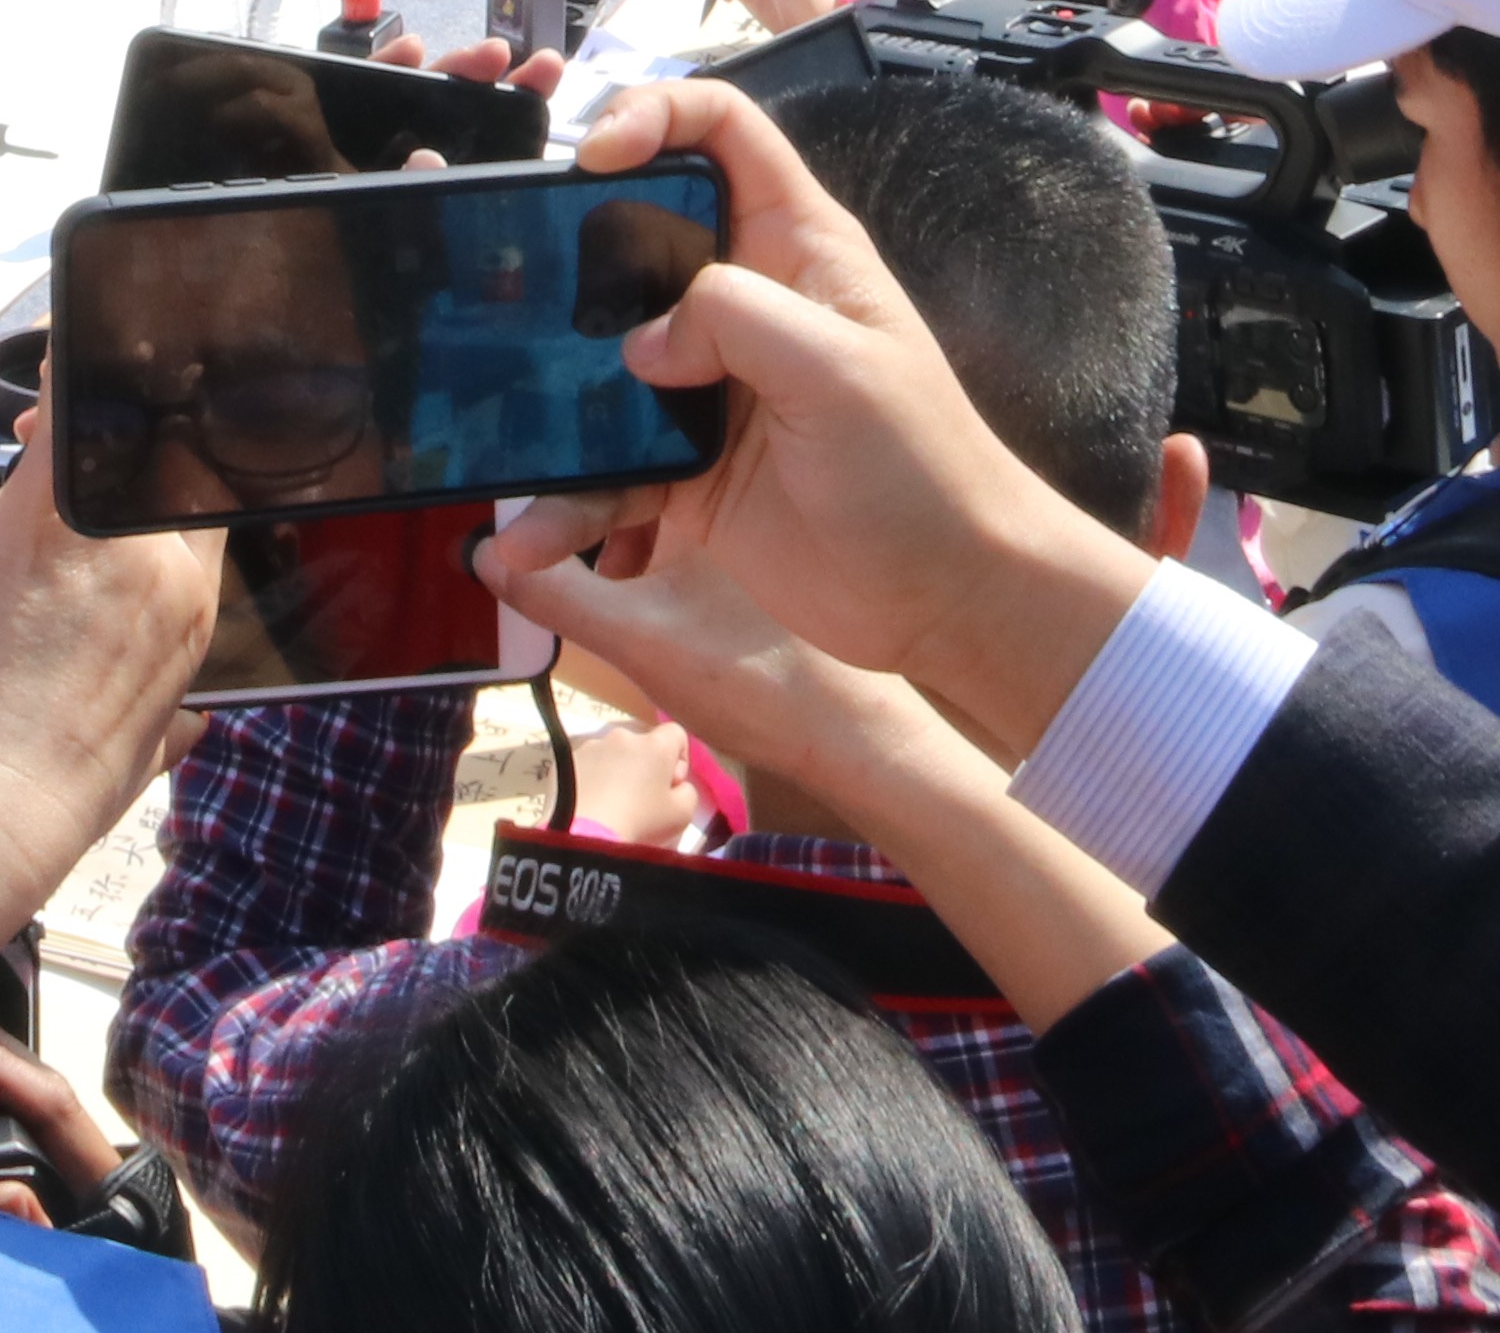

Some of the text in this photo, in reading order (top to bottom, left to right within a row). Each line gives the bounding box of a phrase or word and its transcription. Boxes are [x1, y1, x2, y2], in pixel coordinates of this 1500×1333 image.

[1211, 235, 1247, 255] 4K
[493, 854, 621, 924] EOS 80D
